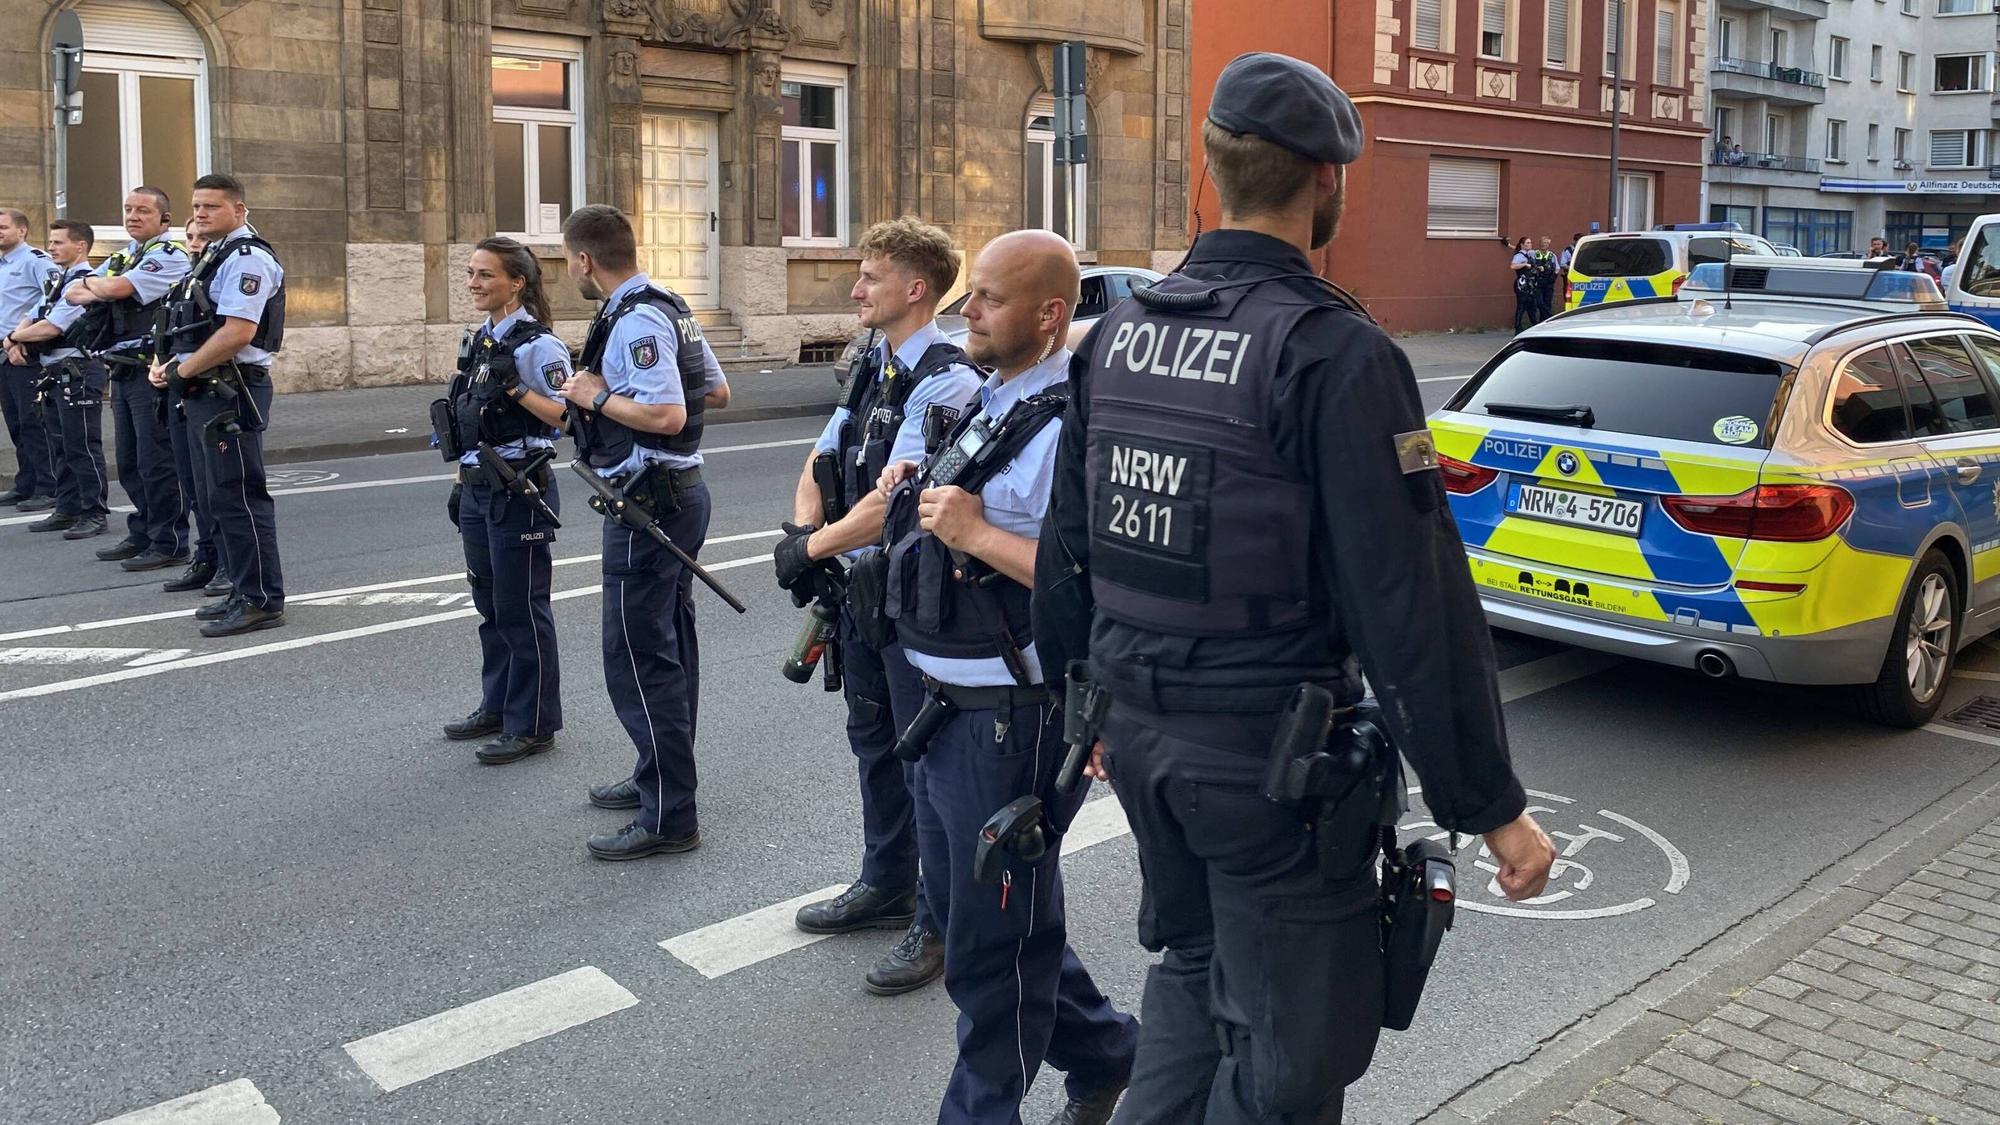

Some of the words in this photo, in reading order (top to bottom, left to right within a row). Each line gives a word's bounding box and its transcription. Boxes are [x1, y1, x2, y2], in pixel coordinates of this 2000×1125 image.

[1920, 181, 1958, 189] Allfinanz
[1574, 282, 1606, 291] POLIZEI
[1104, 321, 1251, 385] POLIZEI
[1484, 439, 1543, 460] POLIZEI
[1110, 445, 1187, 496] NRW
[1108, 494, 1172, 546] 2611
[1518, 487, 1557, 515] NRW
[1565, 495, 1639, 528] 4-5706
[520, 532, 544, 541] POLIZEI
[1486, 577, 1498, 586] BEI
[1499, 580, 1517, 590] STAU
[1520, 585, 1594, 607] RETTUNGSGASSE
[1595, 601, 1627, 613] BILDEN!
